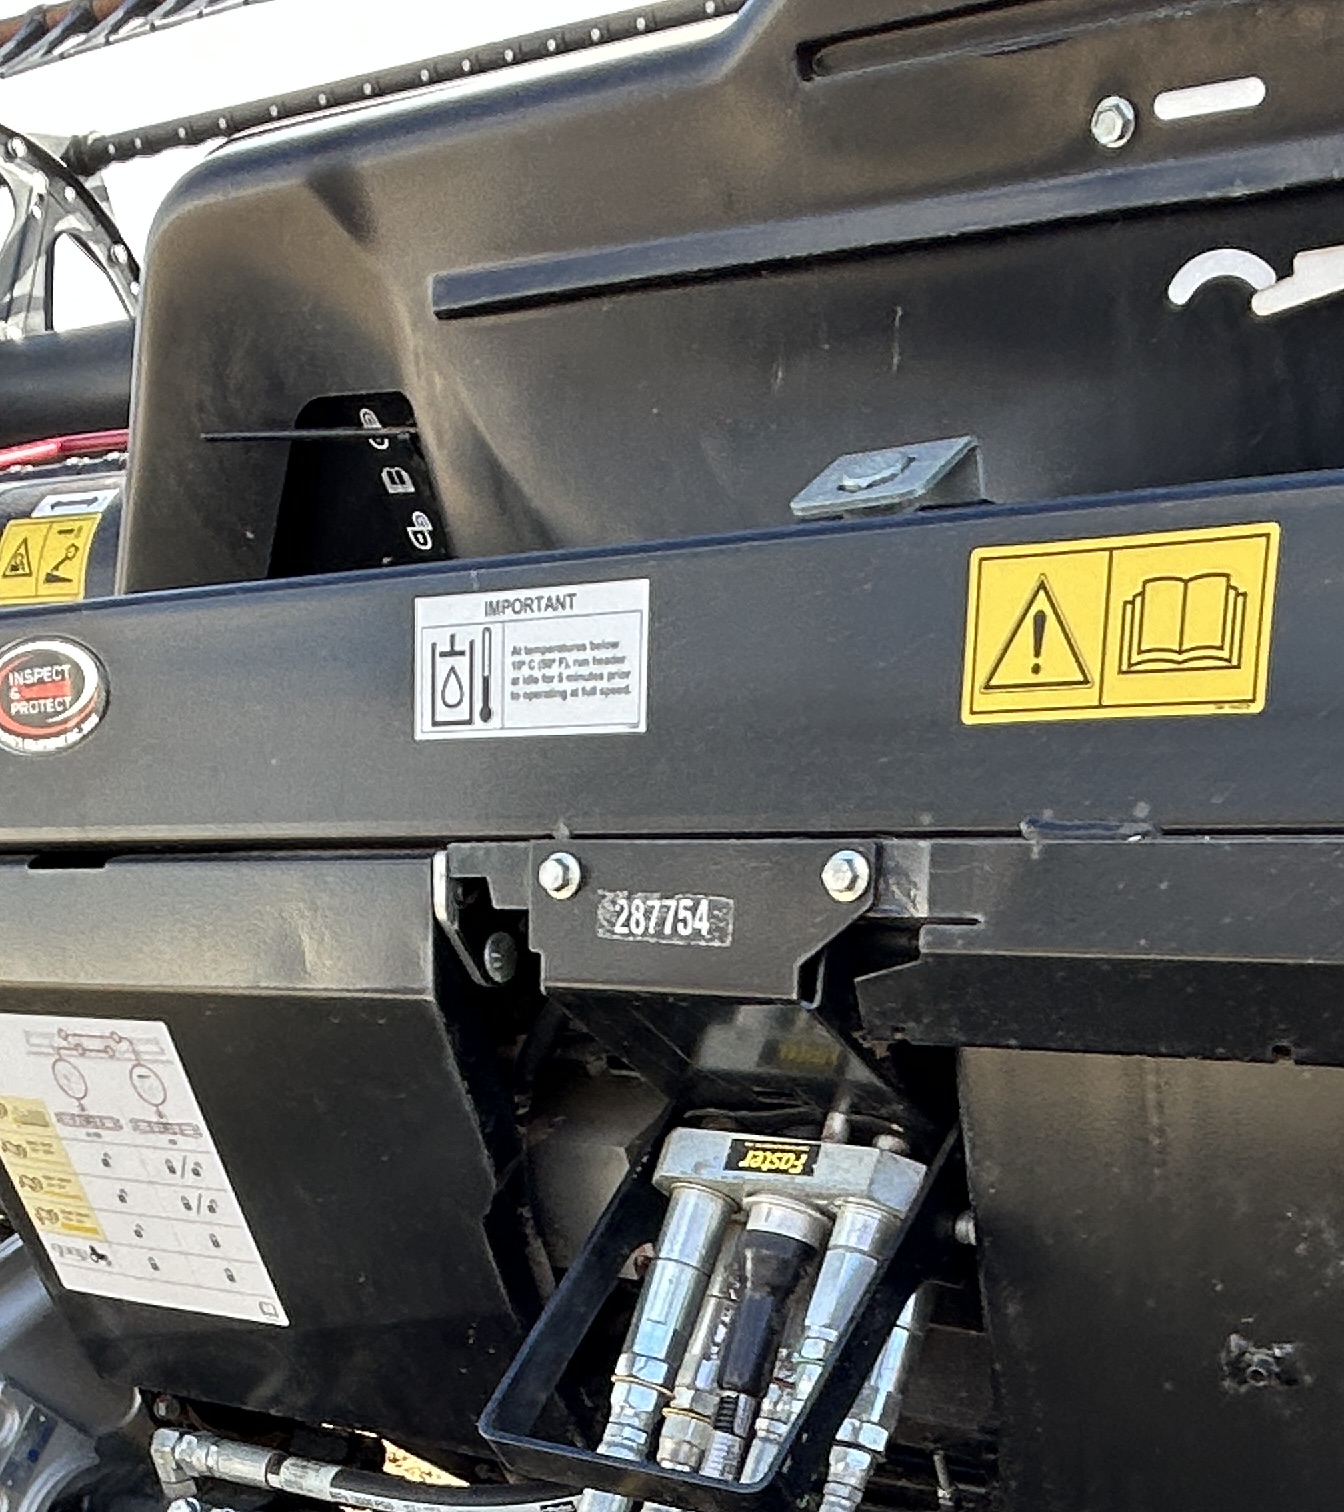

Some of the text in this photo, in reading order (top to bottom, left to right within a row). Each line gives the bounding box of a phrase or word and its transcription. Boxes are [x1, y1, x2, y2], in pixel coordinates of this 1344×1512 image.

[484, 592, 578, 617] IMPORTANT
[511, 639, 620, 657] At temperatures below
[573, 658, 590, 667] run
[592, 653, 627, 666] header
[8, 664, 72, 686] INSPECT
[522, 673, 540, 685] idle
[541, 672, 555, 683] for
[565, 672, 604, 682] minutes
[607, 669, 632, 682] prior
[9, 686, 21, 700] &
[522, 688, 568, 701] operating
[581, 685, 597, 697] full
[599, 684, 632, 698] speed.
[10, 696, 72, 715] PROTECT
[613, 897, 711, 937] 287754
